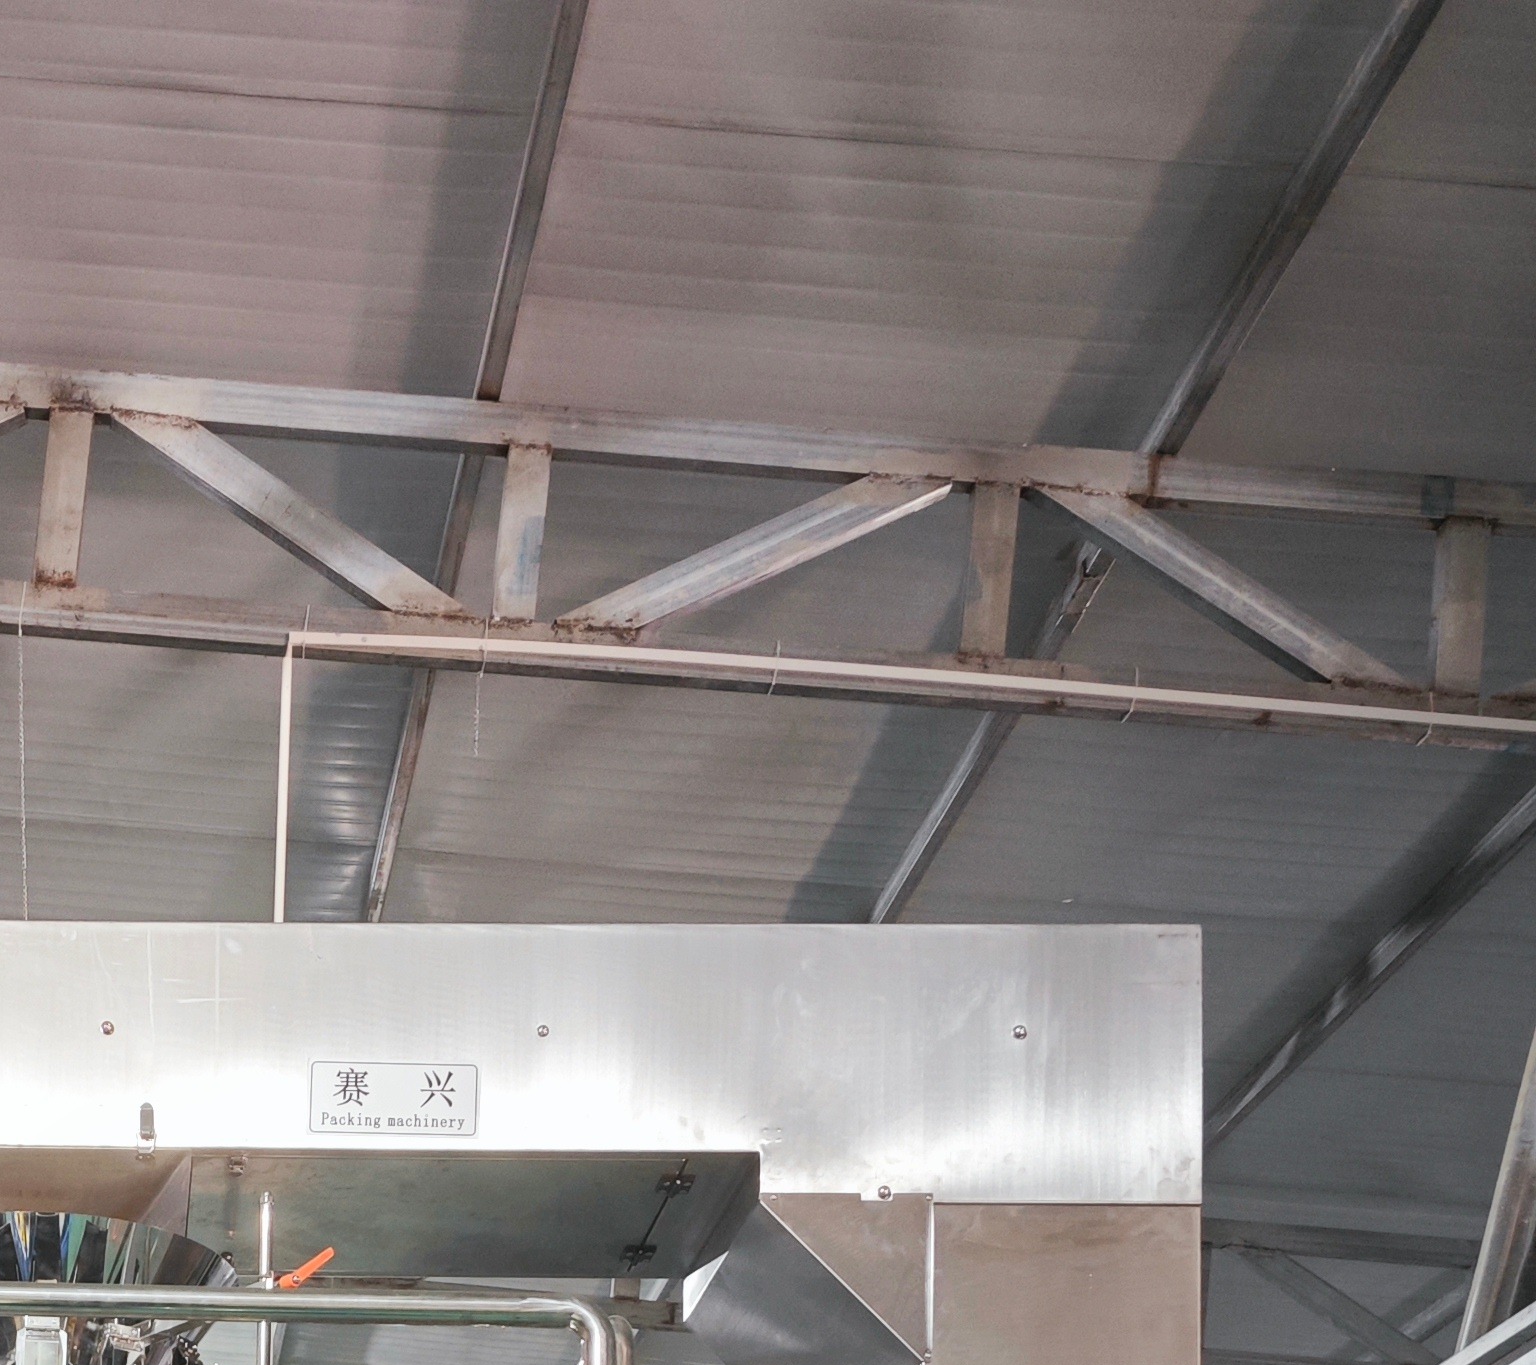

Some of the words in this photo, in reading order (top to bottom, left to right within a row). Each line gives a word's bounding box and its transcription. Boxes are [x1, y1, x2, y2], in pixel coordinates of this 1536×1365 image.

[333, 1067, 456, 1108] 赛兴
[321, 1112, 381, 1129] Packing
[387, 1114, 465, 1130] machinery
